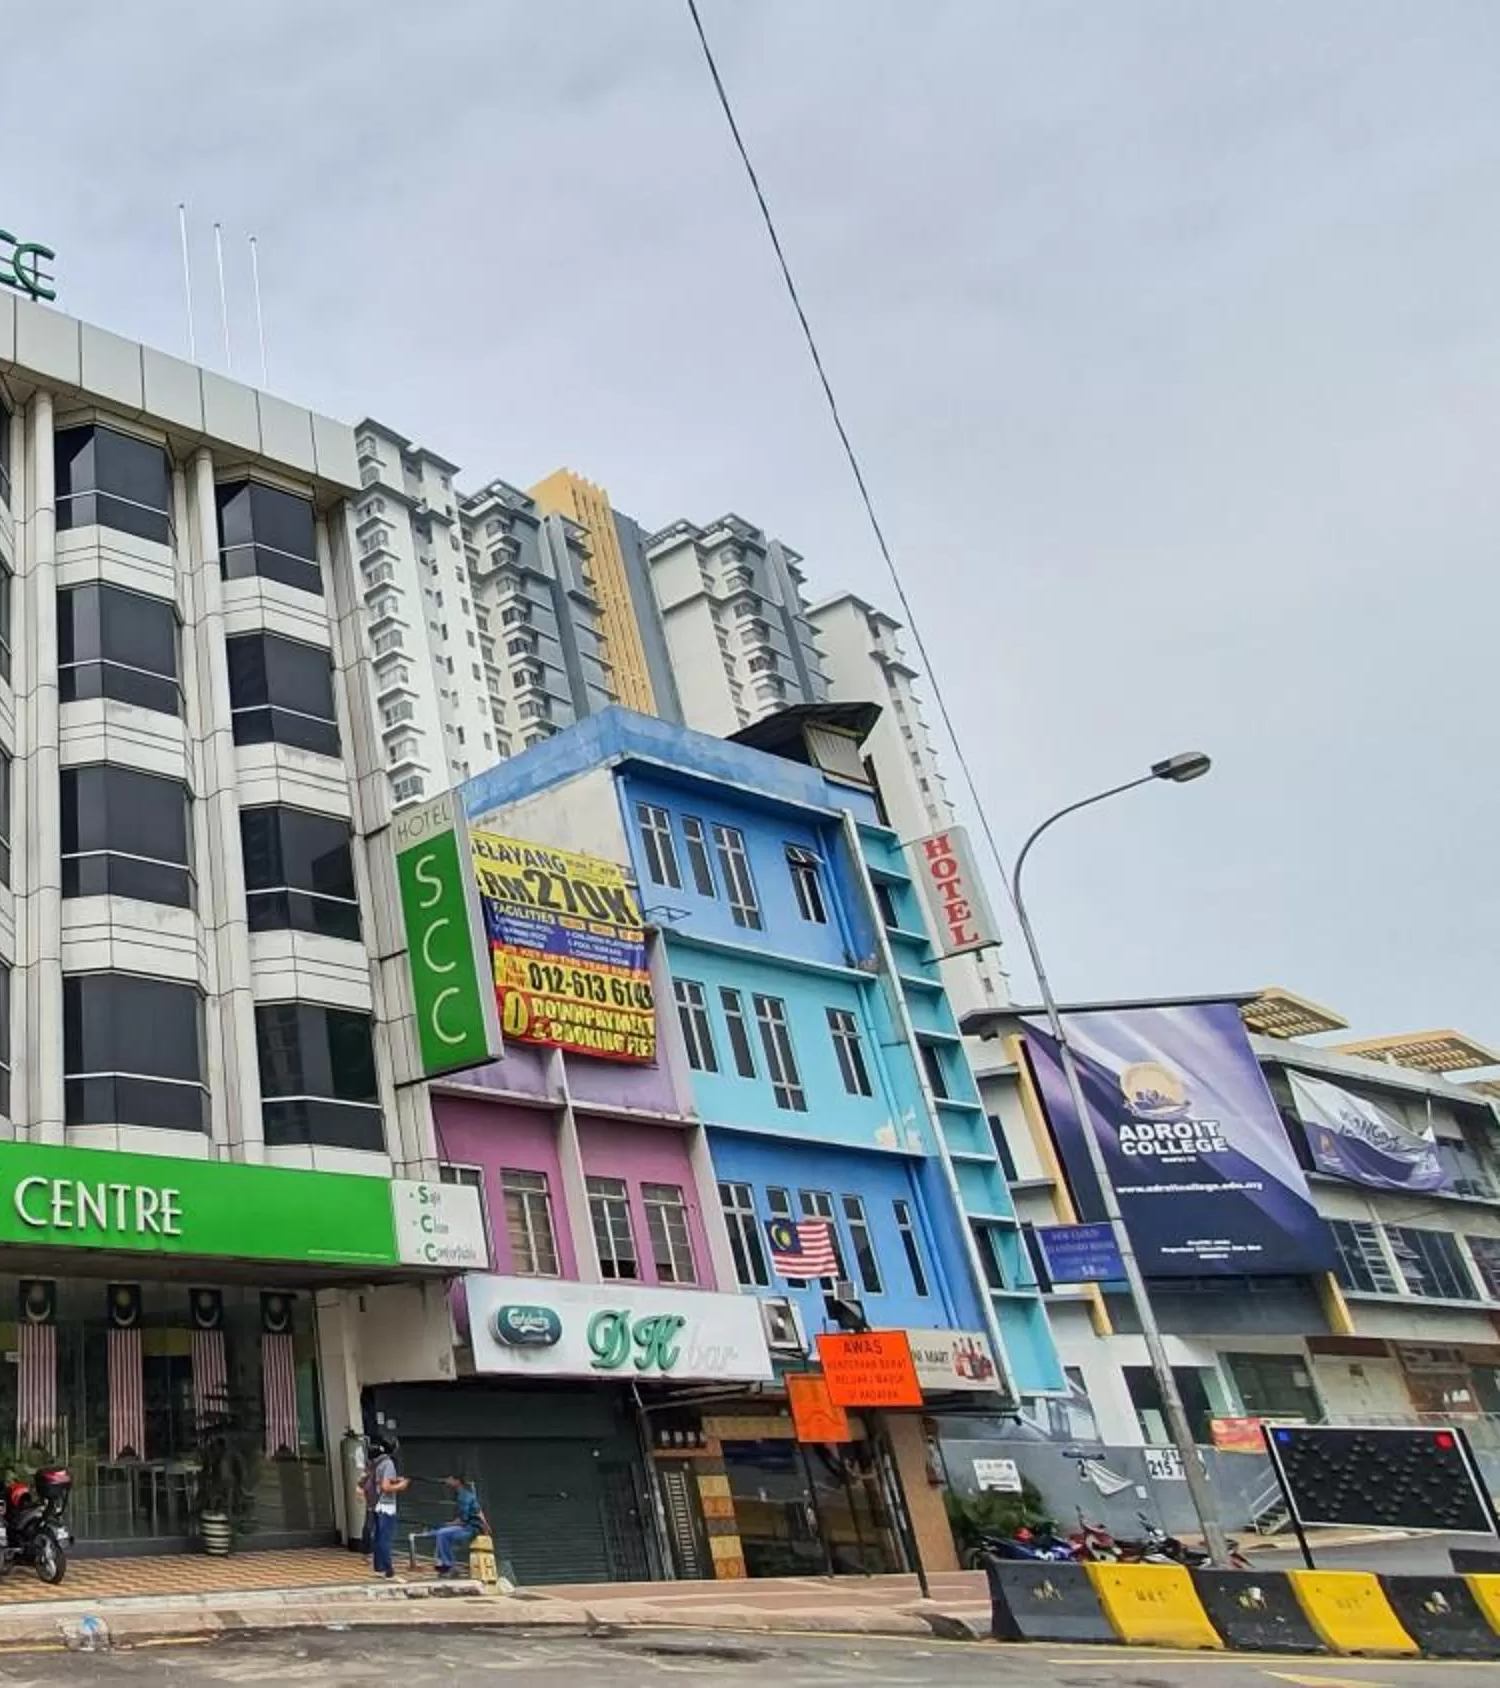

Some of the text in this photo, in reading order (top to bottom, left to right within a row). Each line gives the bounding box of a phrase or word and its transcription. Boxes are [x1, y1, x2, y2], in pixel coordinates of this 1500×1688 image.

[397, 804, 450, 846] HOTEL
[922, 832, 981, 947] HOTEL
[528, 961, 608, 1003] 012-613
[1119, 1121, 1220, 1142] ADROIT
[1121, 1137, 1229, 1156] COLLEGE
[14, 1176, 184, 1237] CENTRE
[843, 1339, 883, 1356] AWAS
